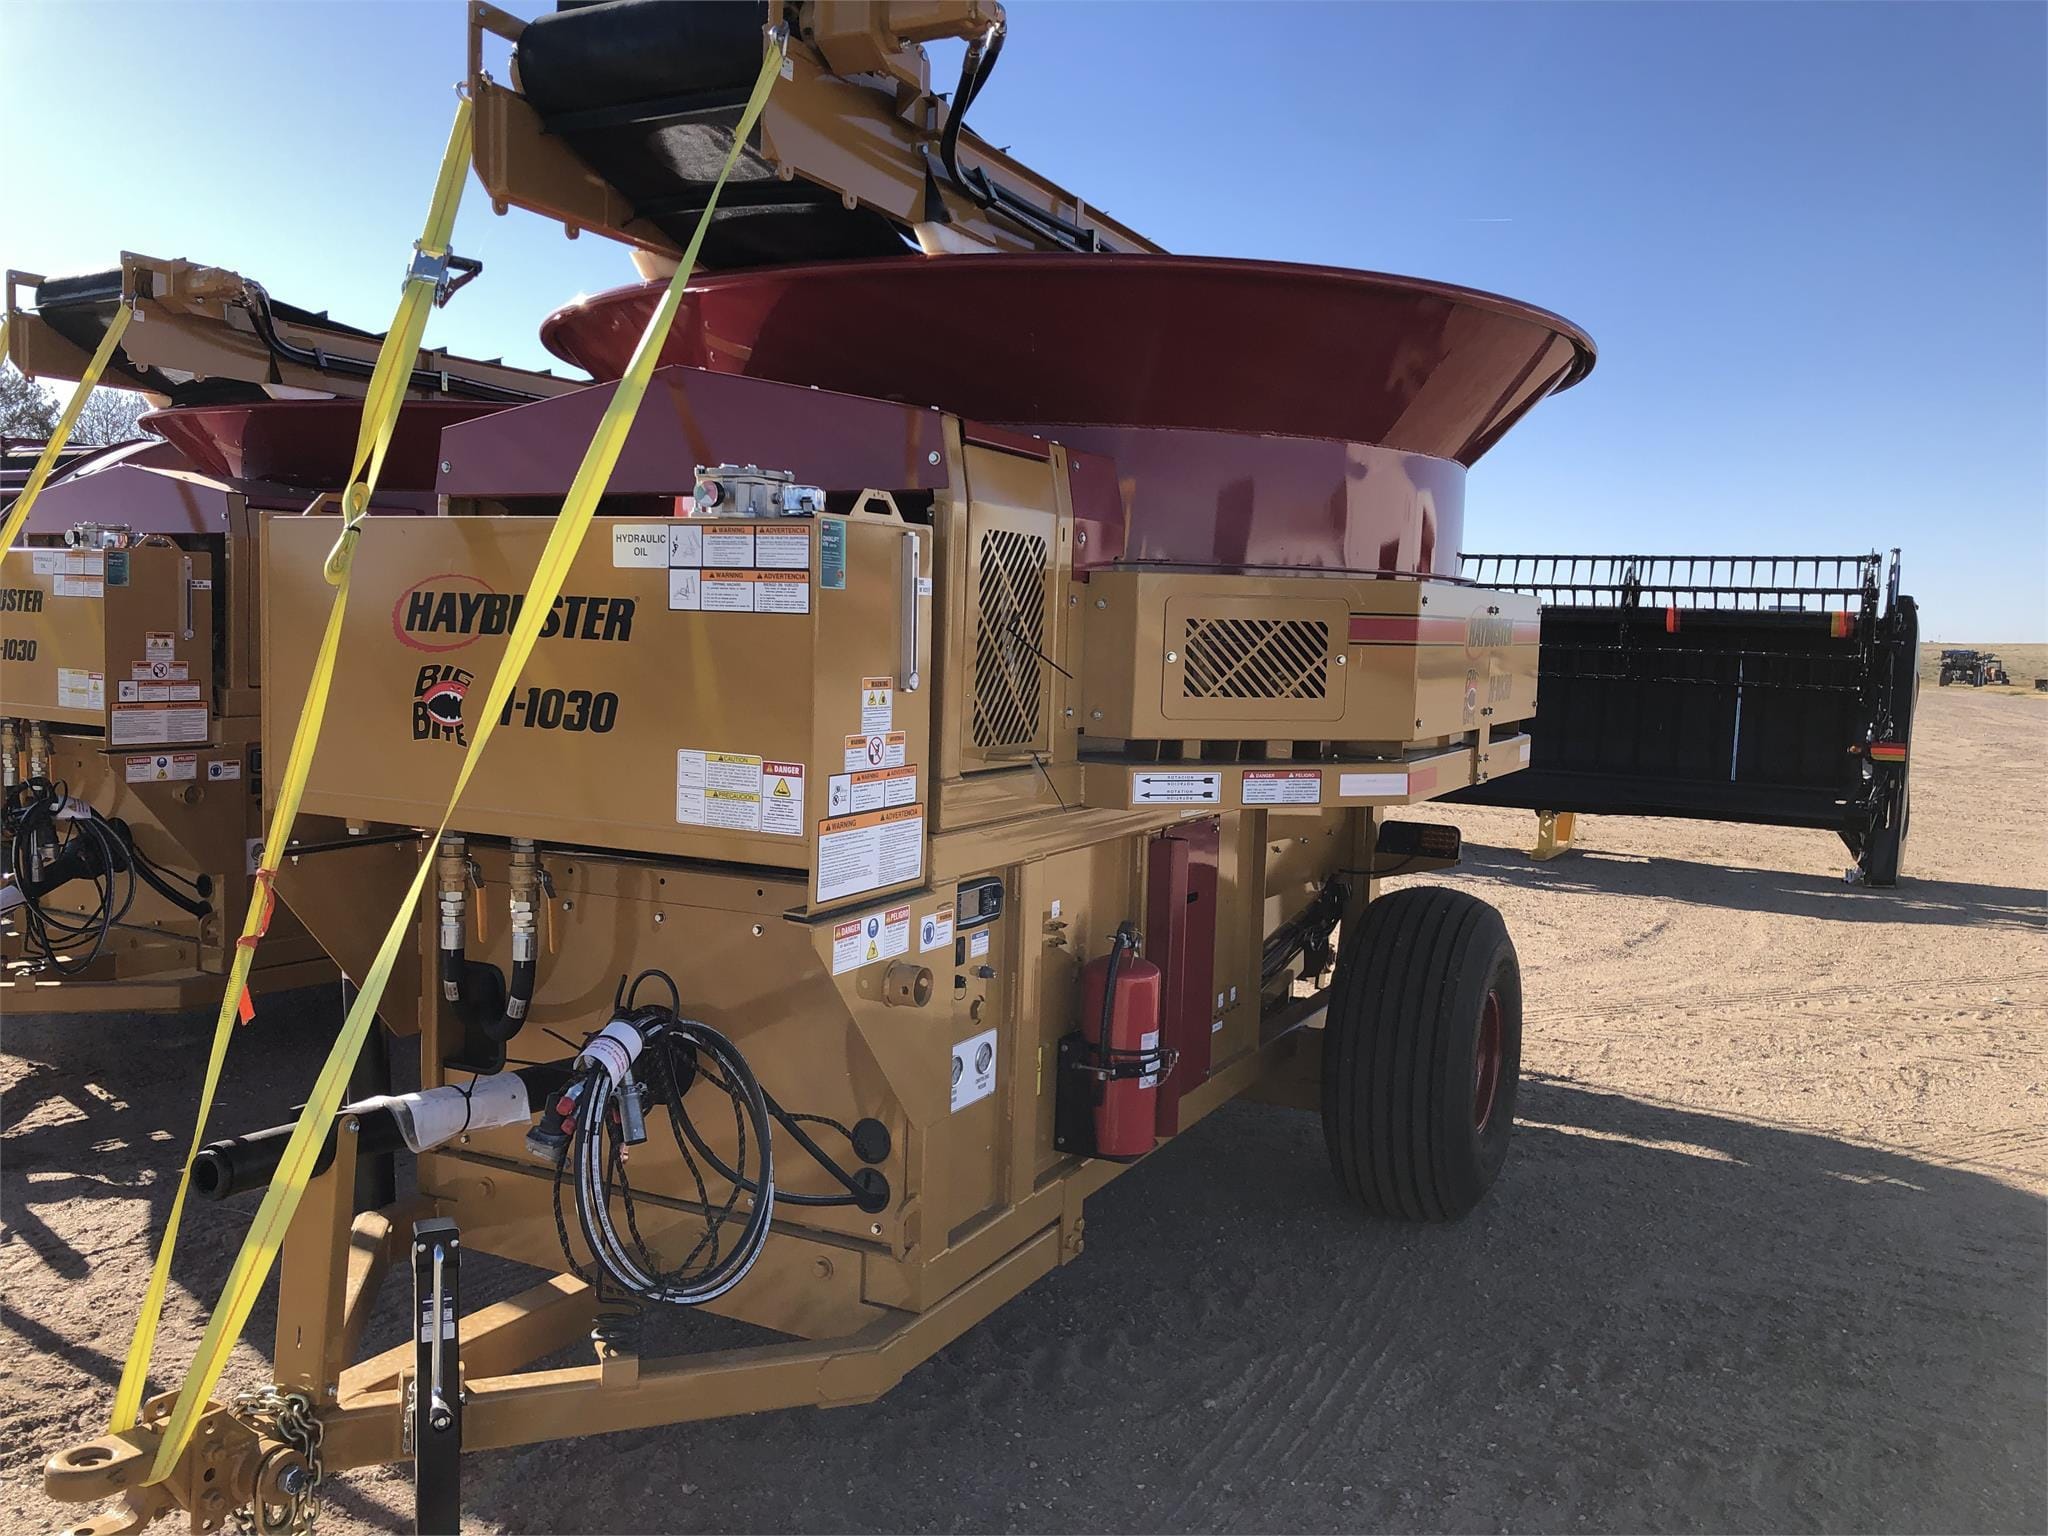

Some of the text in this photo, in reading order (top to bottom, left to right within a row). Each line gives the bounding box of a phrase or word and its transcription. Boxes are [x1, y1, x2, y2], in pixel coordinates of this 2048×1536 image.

[615, 534, 666, 544] HYDRAULIC
[633, 547, 648, 556] OIL
[414, 664, 475, 698] BIG
[412, 701, 468, 748] BITE
[774, 765, 800, 775] DANGER
[885, 808, 918, 821] ADVERTENCIA
[831, 819, 857, 830] WARNING
[890, 909, 910, 921] PELIGRO
[841, 924, 861, 936] DANGER
